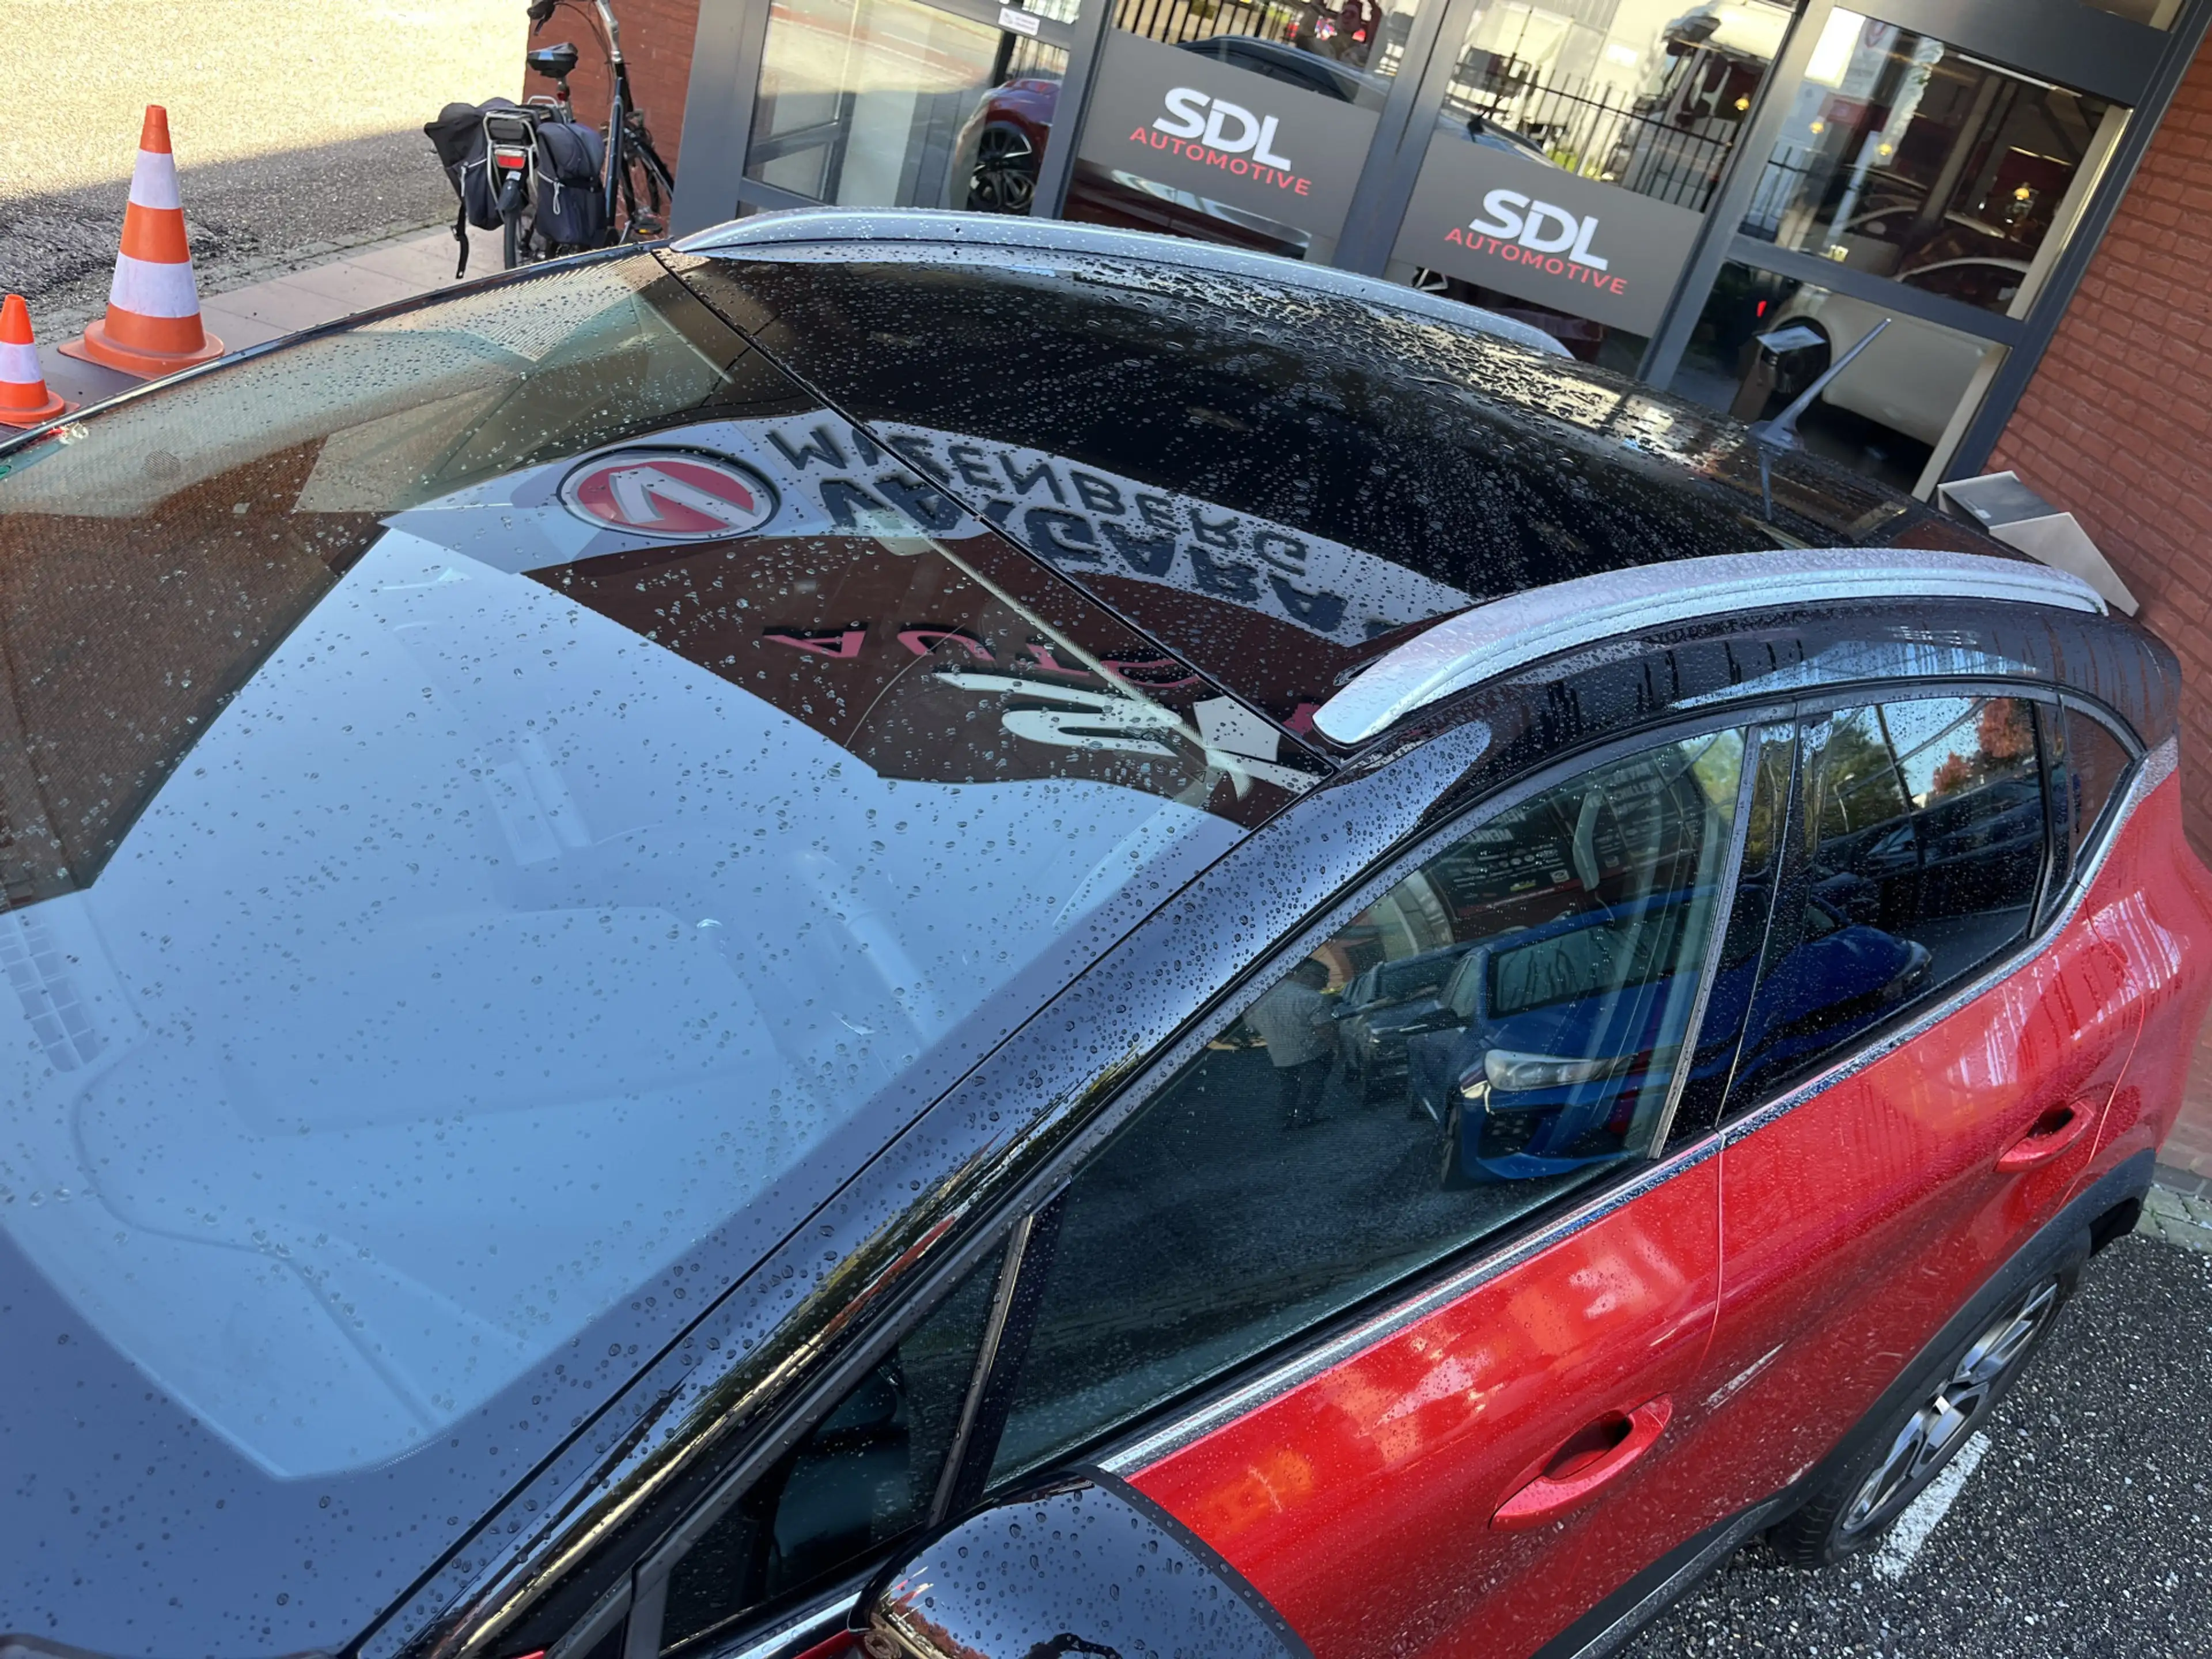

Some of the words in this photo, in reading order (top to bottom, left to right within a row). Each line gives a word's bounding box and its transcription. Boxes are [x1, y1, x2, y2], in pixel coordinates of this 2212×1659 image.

[1129, 126, 1313, 196] AUTOMOTIVE
[1152, 87, 1291, 172] SDL
[1444, 228, 1628, 295] AUTOMOTIVE
[1468, 189, 1609, 271] SDL
